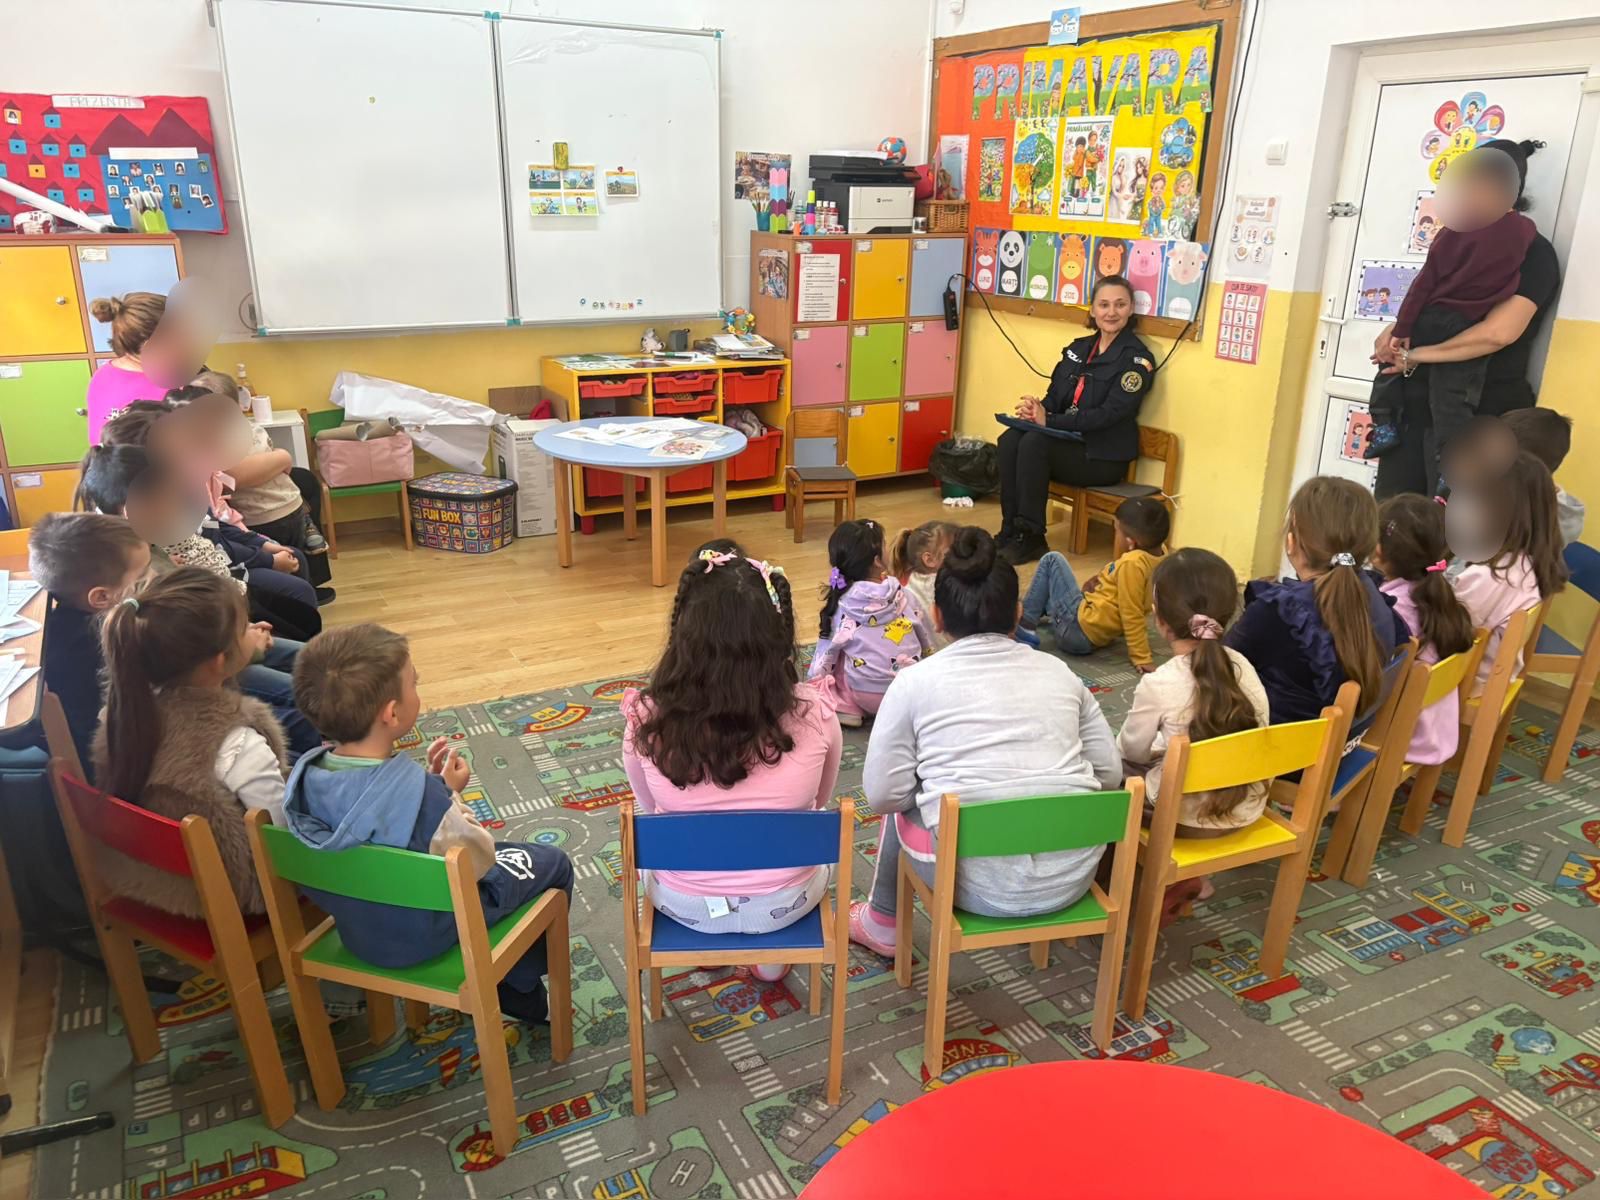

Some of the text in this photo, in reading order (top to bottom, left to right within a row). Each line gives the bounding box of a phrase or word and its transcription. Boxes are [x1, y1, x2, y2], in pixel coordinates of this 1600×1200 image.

[422, 508, 462, 524] FUN BOX
[669, 1158, 695, 1186] H
